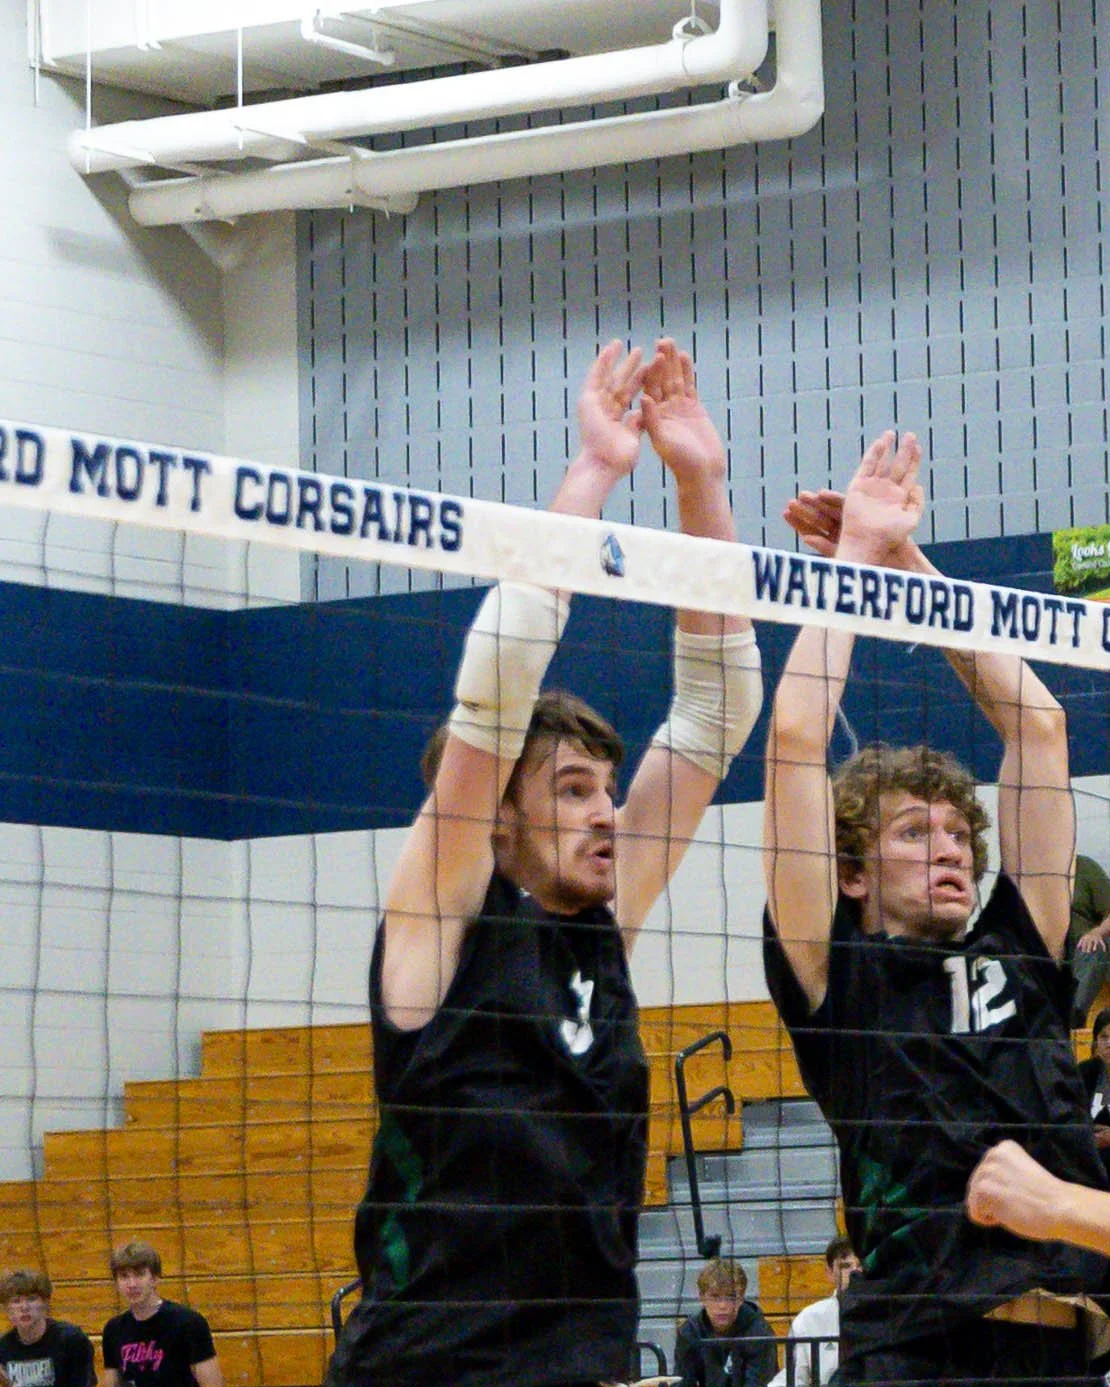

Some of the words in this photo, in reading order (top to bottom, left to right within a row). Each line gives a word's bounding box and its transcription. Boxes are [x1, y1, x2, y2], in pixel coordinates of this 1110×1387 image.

[69, 440, 214, 511] MOTT
[233, 467, 465, 552] CORSAIRS
[751, 551, 974, 631] WATERFORD
[990, 590, 1088, 648] MOTT
[942, 955, 1017, 1034] 12
